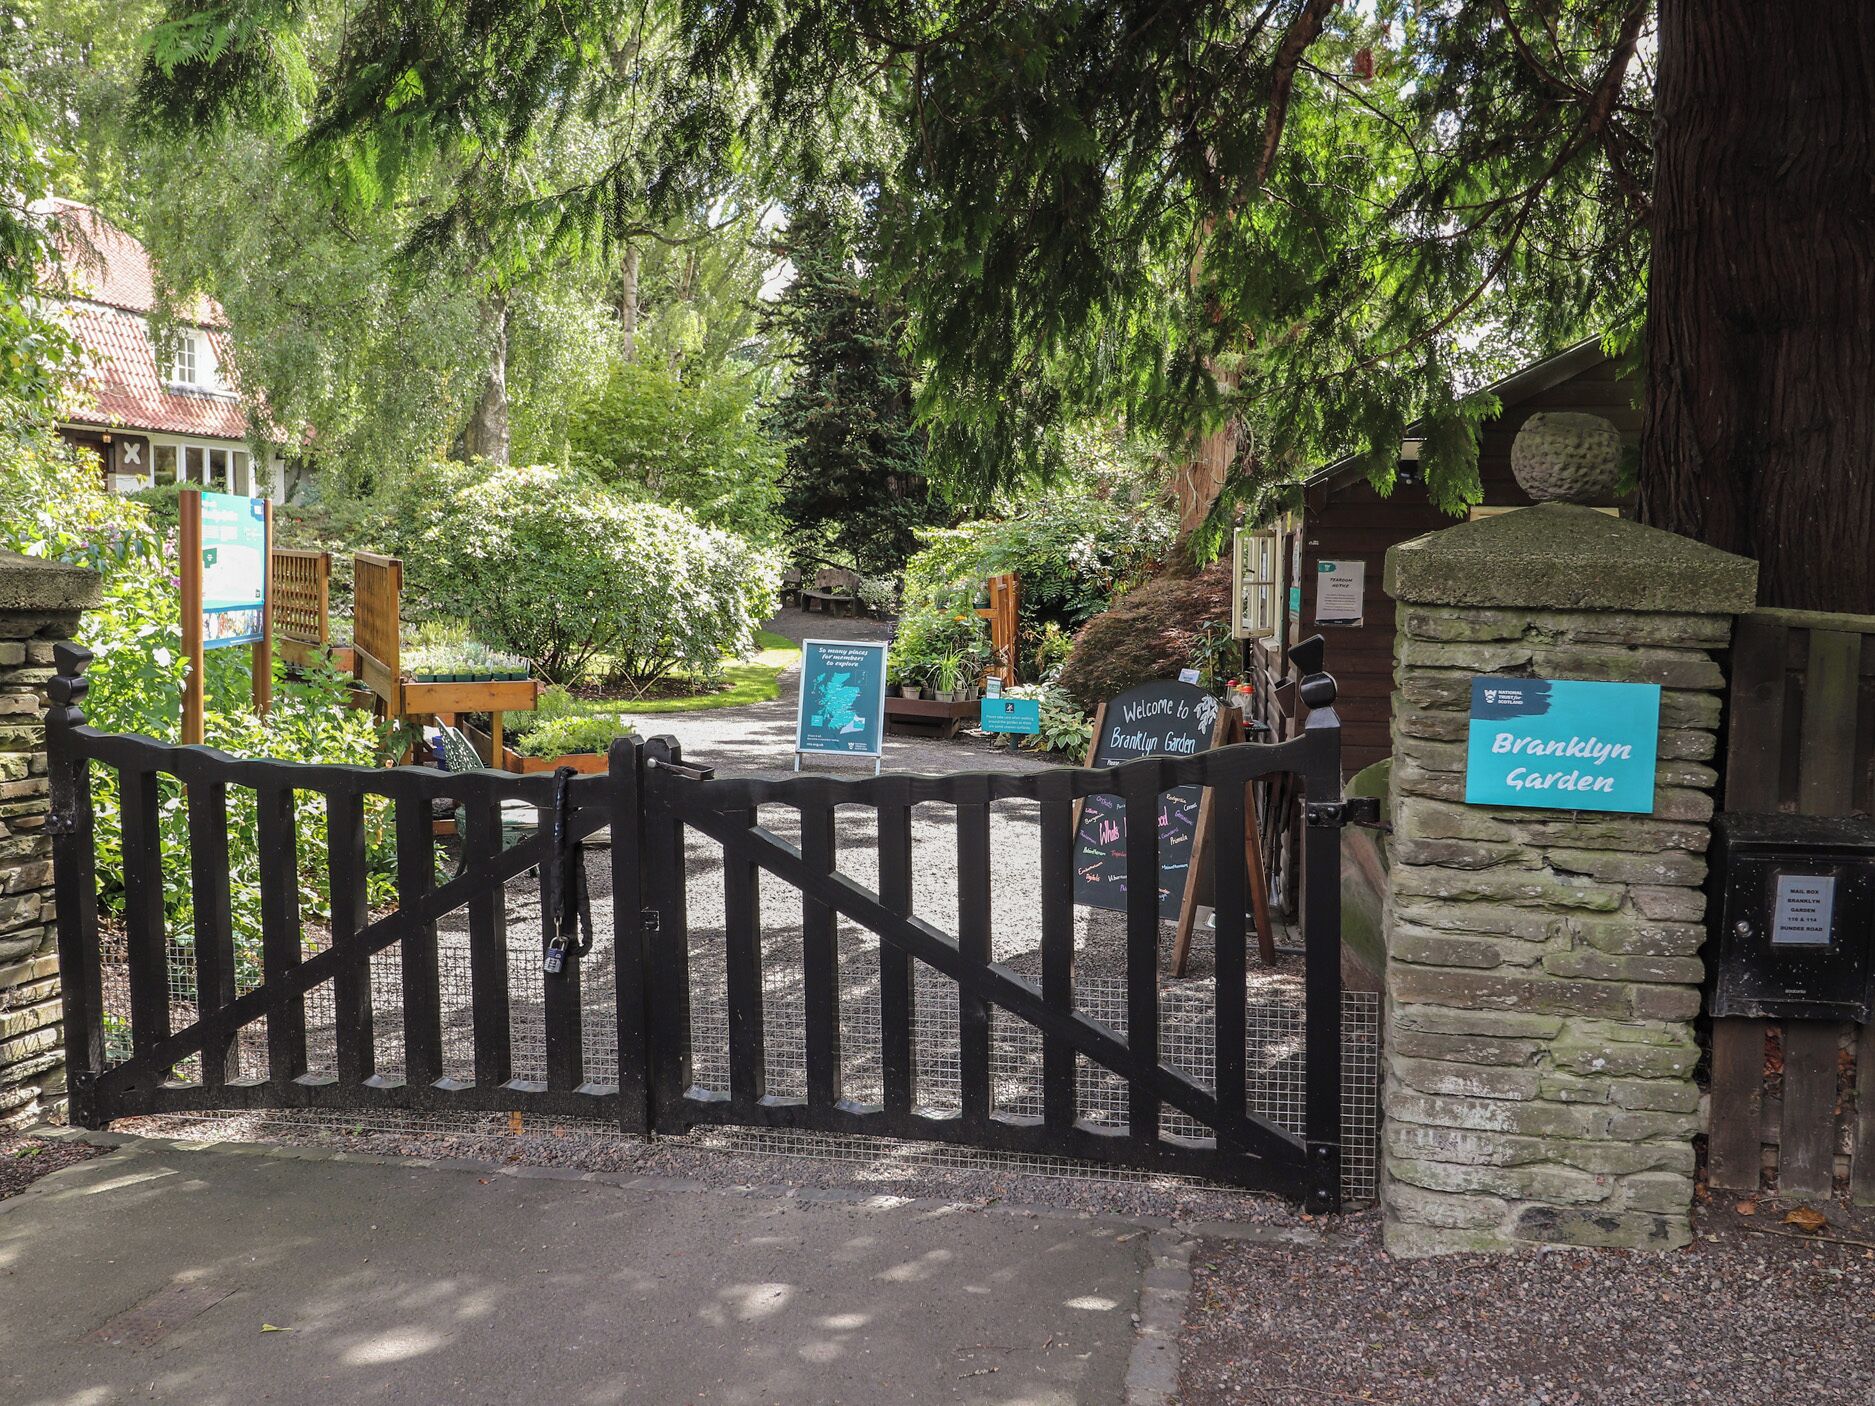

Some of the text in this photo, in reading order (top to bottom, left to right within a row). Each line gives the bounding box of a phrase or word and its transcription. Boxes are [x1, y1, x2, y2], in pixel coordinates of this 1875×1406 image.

[1123, 698, 1189, 723] Welcome to
[1110, 726, 1196, 757] Branklyn Garden
[1491, 732, 1632, 765] Branklyn
[1506, 767, 1615, 793] Garden
[1099, 820, 1120, 846] Whats
